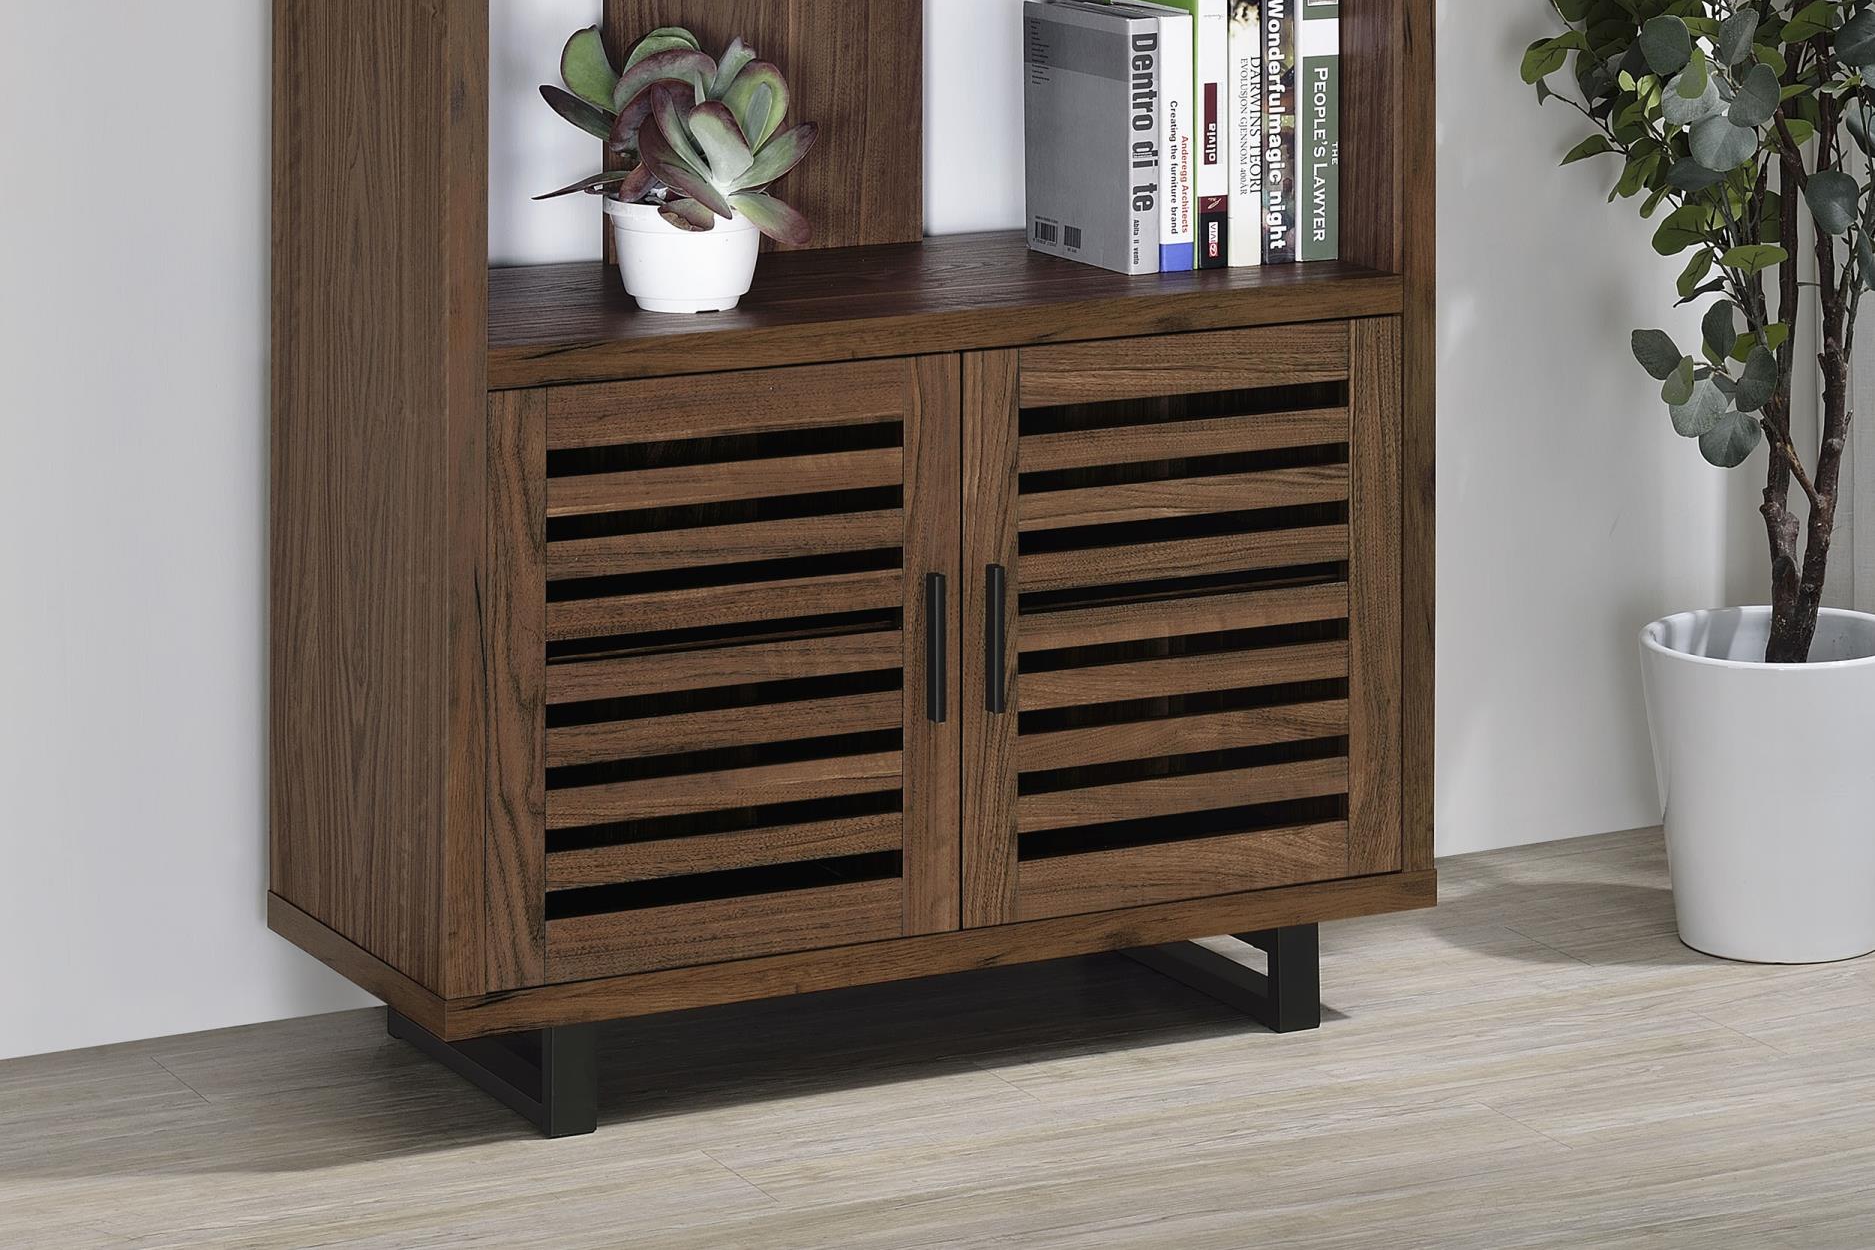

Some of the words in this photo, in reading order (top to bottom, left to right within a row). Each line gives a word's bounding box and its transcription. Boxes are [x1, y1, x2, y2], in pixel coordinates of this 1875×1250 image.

[1132, 32, 1158, 131] Dentro
[1239, 58, 1248, 114] EVOLUSJON
[1250, 56, 1261, 136] DARWINS
[1169, 100, 1178, 141] Creating
[1313, 67, 1329, 158] PEOPLE'S
[1132, 141, 1158, 168] di
[1170, 144, 1178, 160] the
[1180, 136, 1189, 182] Anderegg
[1239, 117, 1248, 165] GJENNOM
[1170, 163, 1178, 202] furniture
[1250, 142, 1261, 194] TEORI
[1132, 183, 1157, 212] te
[1181, 185, 1189, 233] Architects
[1267, 190, 1287, 250] night
[1313, 163, 1328, 241] LAWYER
